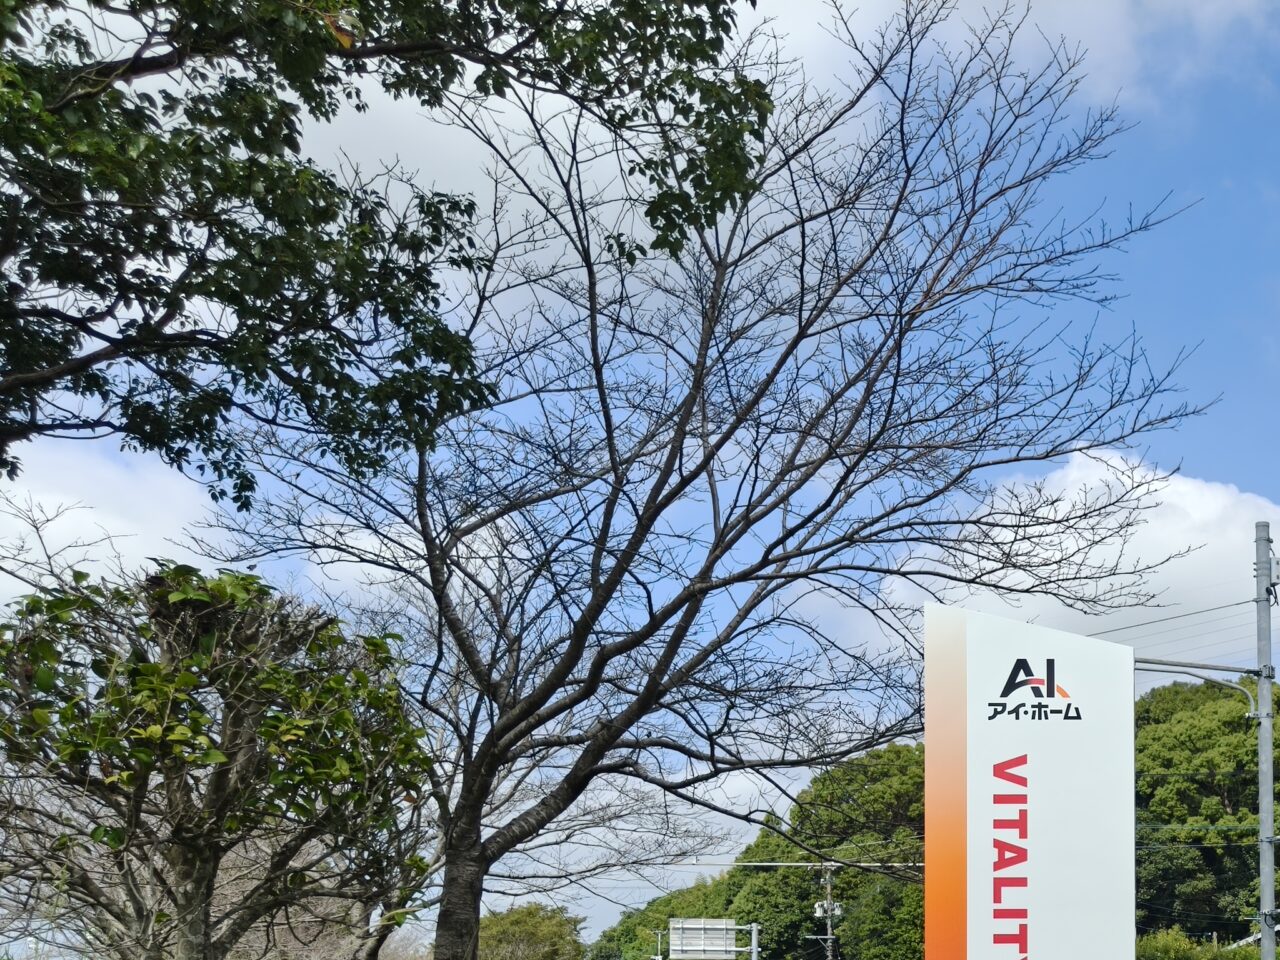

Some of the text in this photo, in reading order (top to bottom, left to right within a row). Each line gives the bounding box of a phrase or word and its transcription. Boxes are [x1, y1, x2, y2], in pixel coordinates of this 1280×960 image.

[988, 701, 1082, 720] アイ・ホーム
